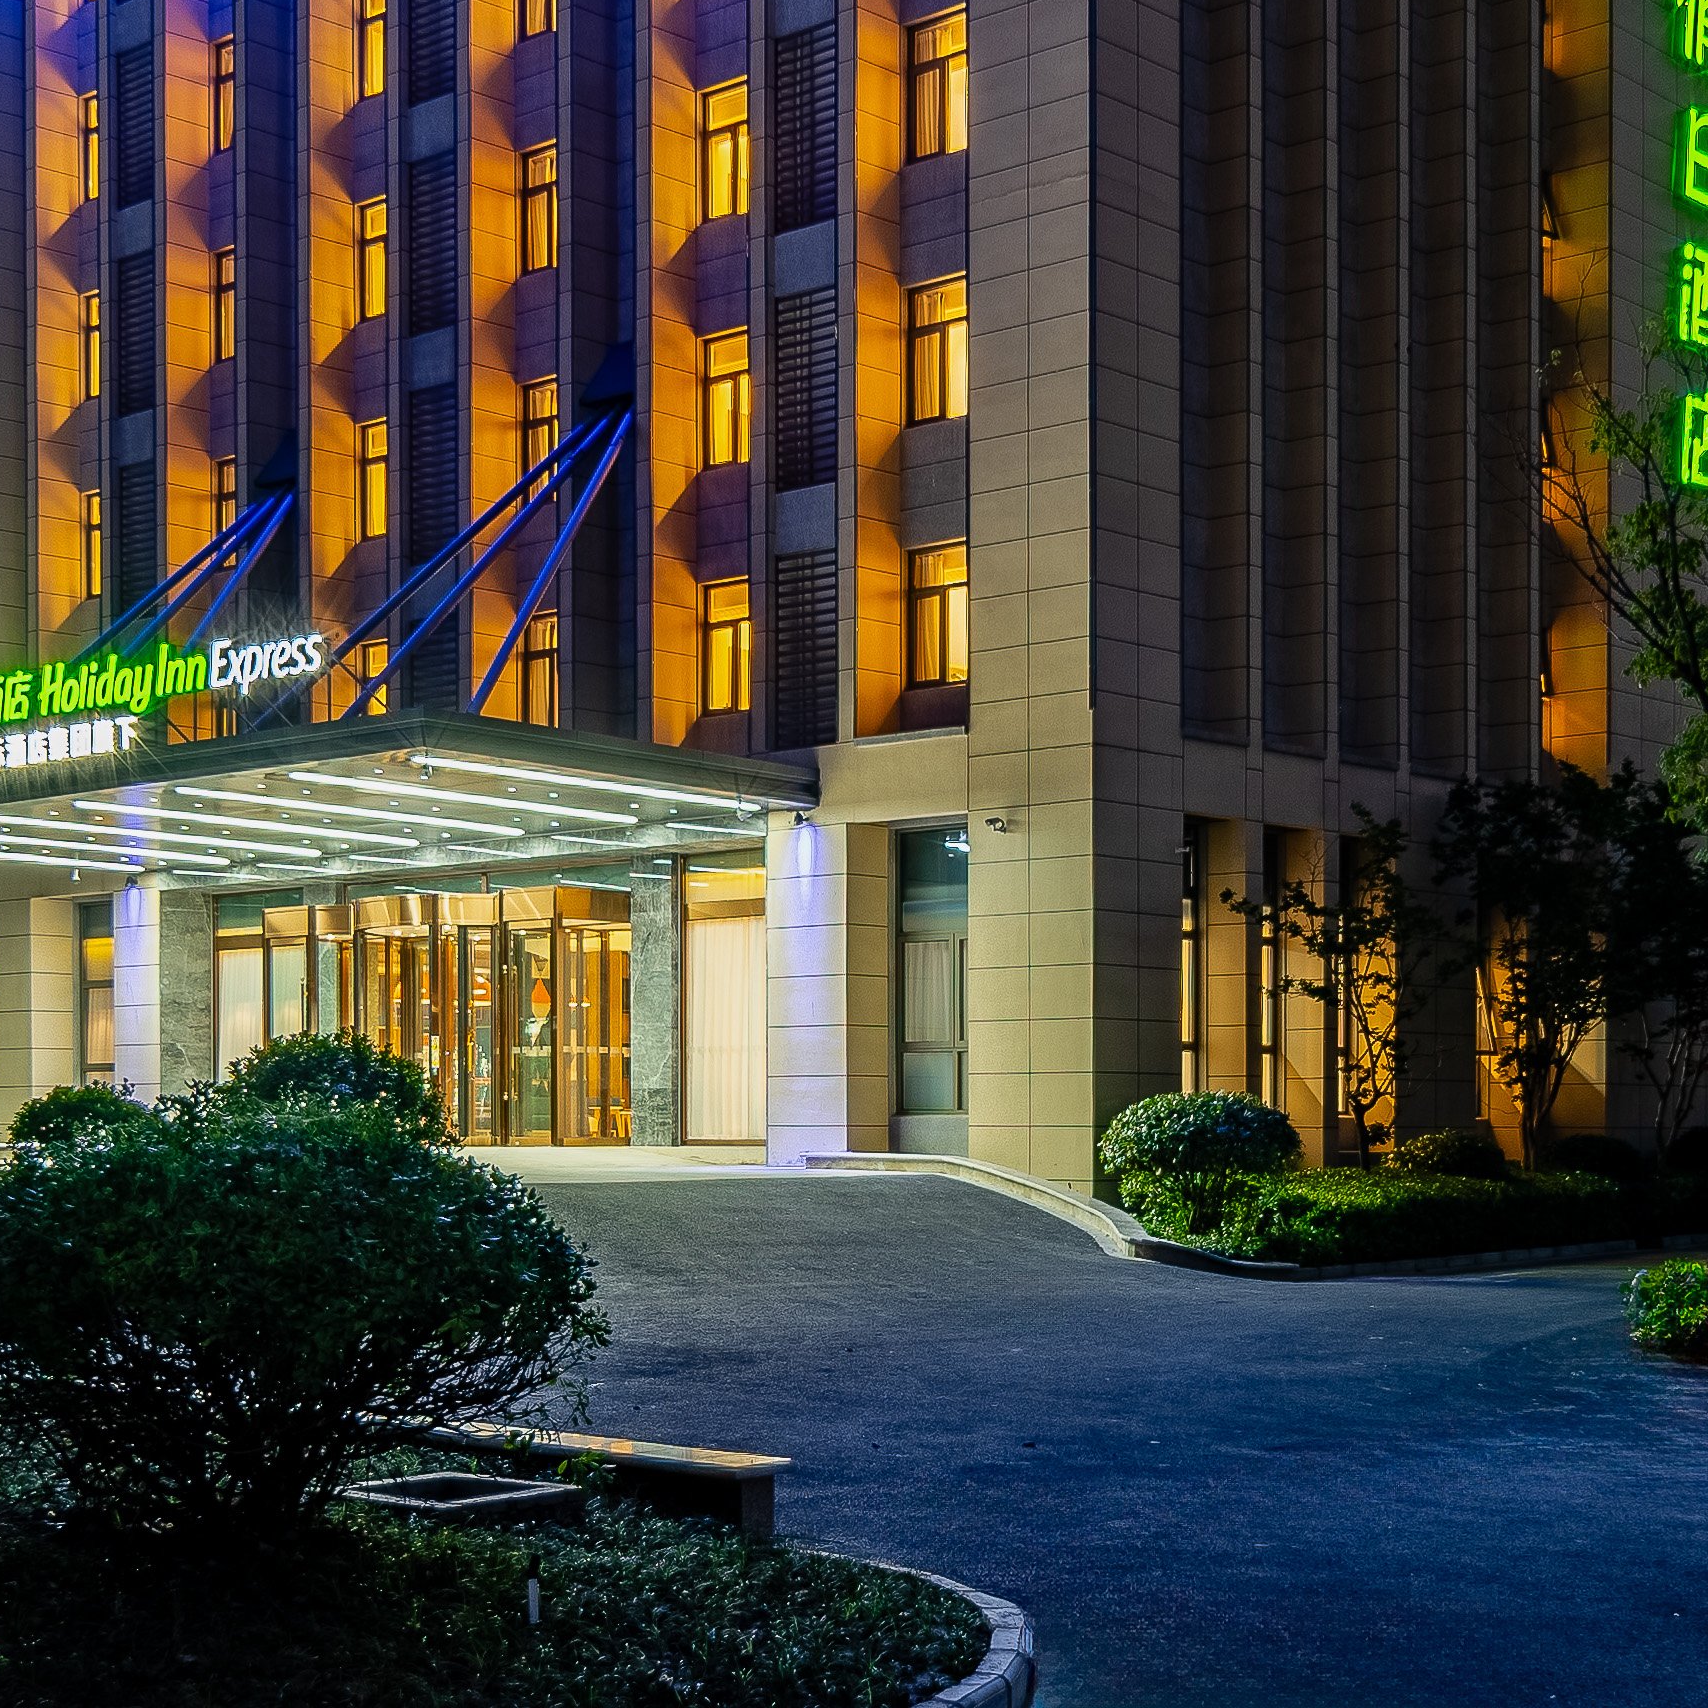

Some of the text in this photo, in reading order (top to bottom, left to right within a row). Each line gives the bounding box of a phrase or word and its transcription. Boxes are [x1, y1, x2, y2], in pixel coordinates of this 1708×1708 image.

[36, 652, 155, 718] Holiday
[154, 641, 207, 698] Inn
[208, 633, 324, 696] Express
